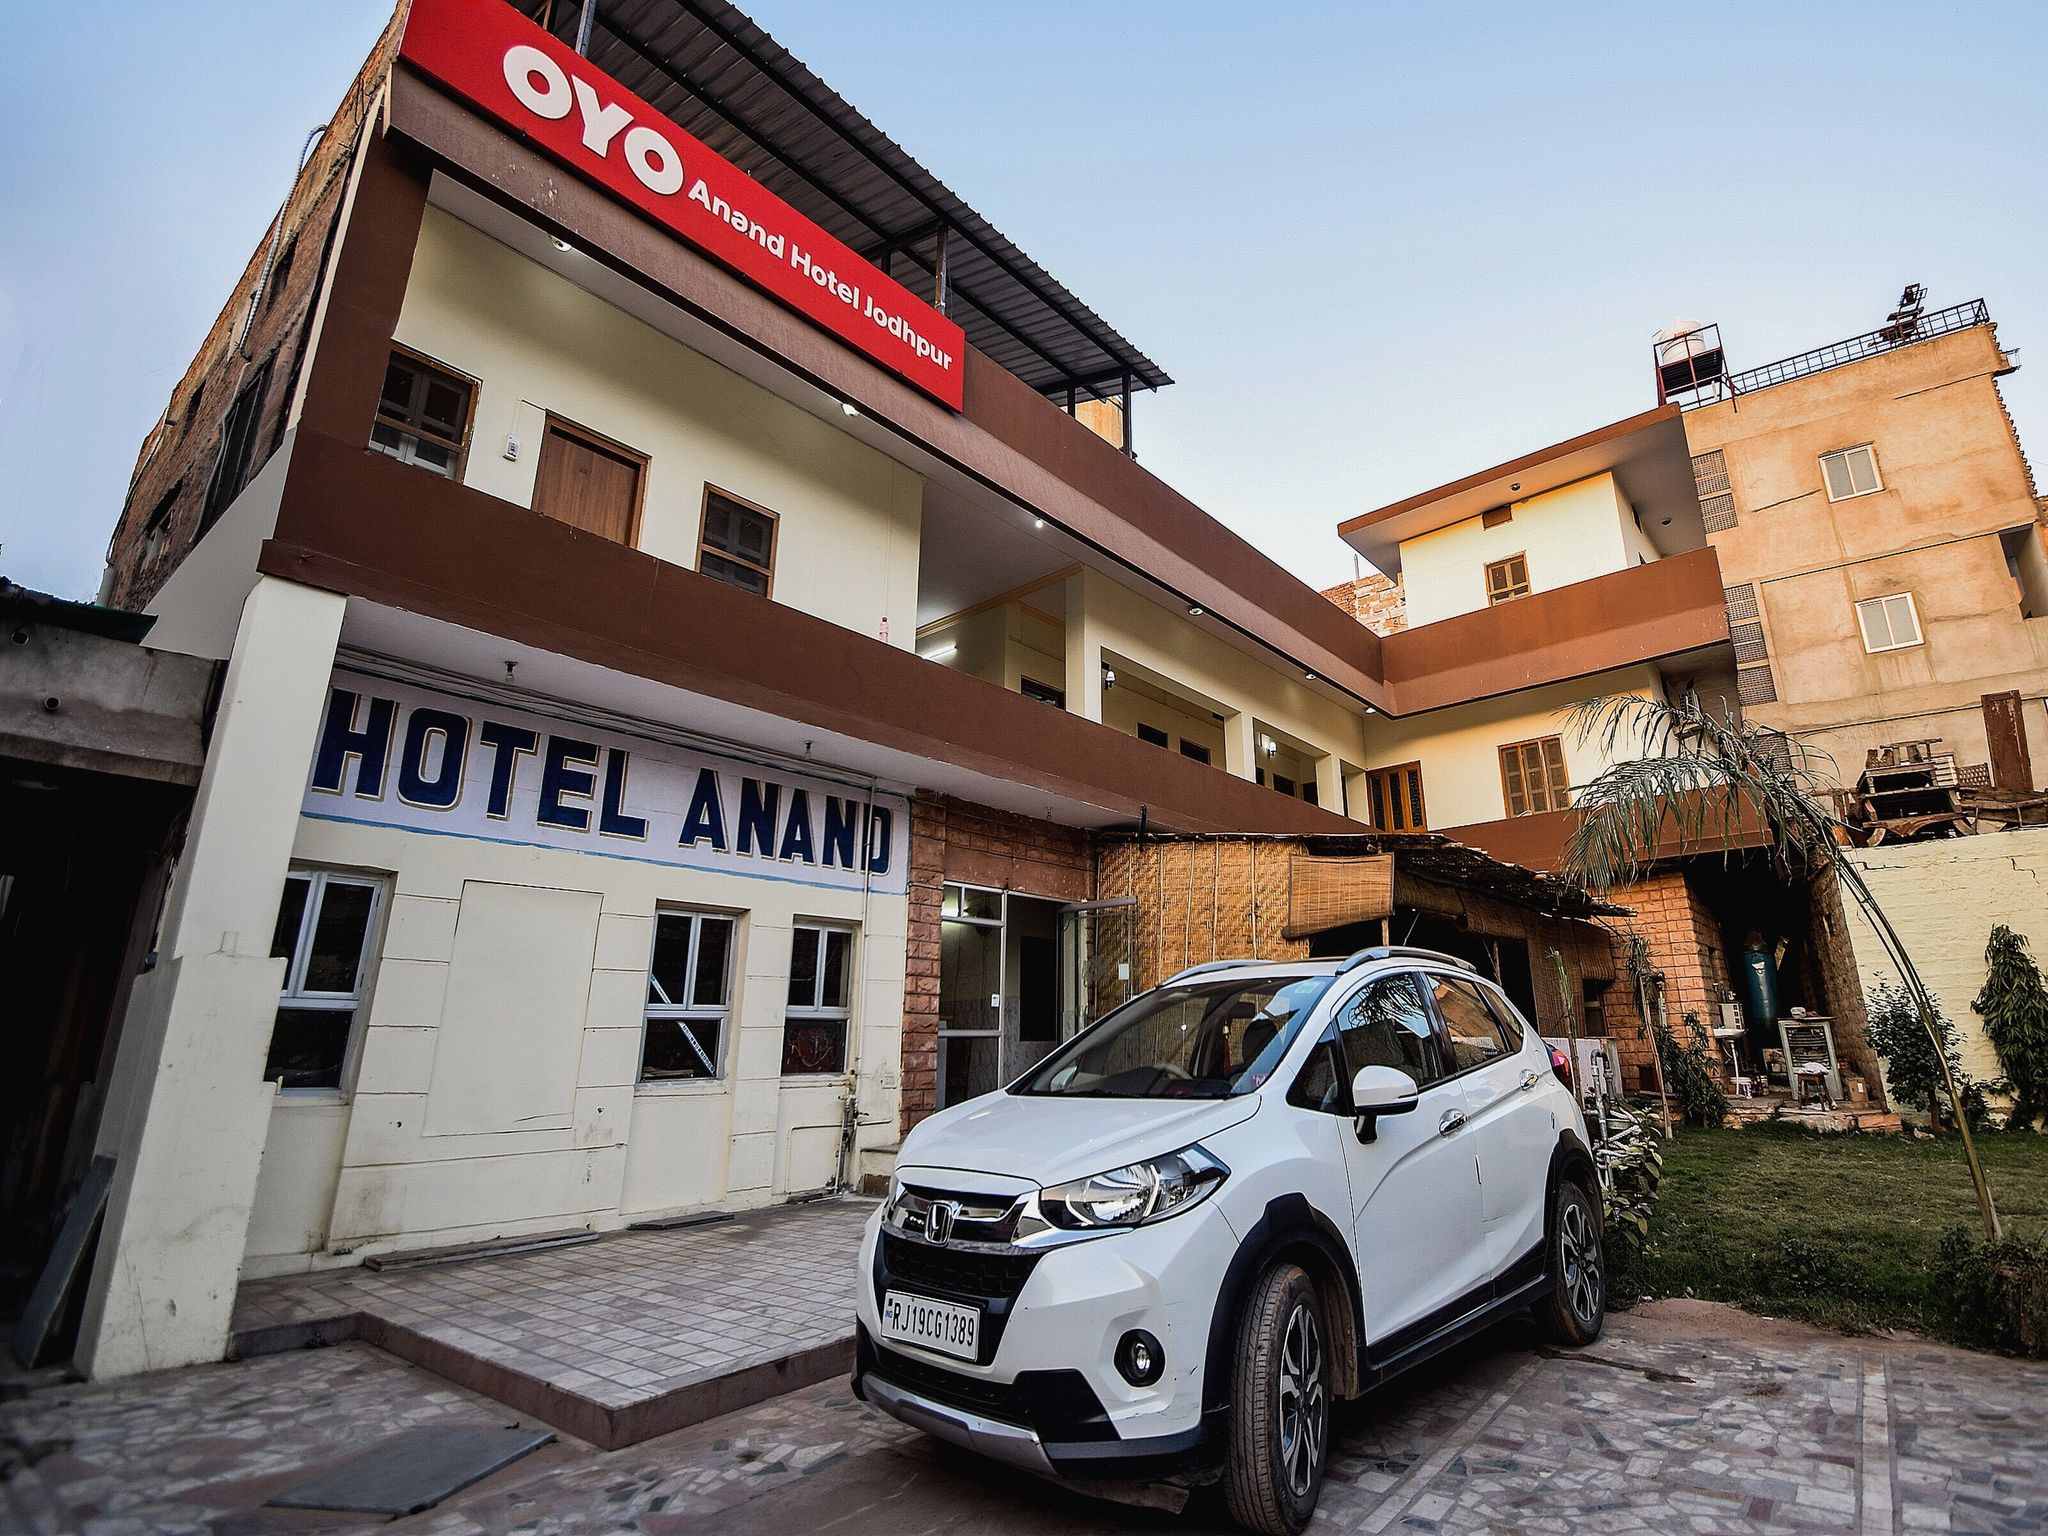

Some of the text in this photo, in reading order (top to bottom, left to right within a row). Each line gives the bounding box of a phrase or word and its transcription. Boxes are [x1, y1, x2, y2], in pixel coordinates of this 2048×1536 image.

[502, 44, 684, 196] OYO
[687, 179, 954, 372] Anand Hotel Jodhpur
[312, 687, 895, 877] HOTEL ANAND
[893, 1302, 975, 1347] RJ19CG1389
